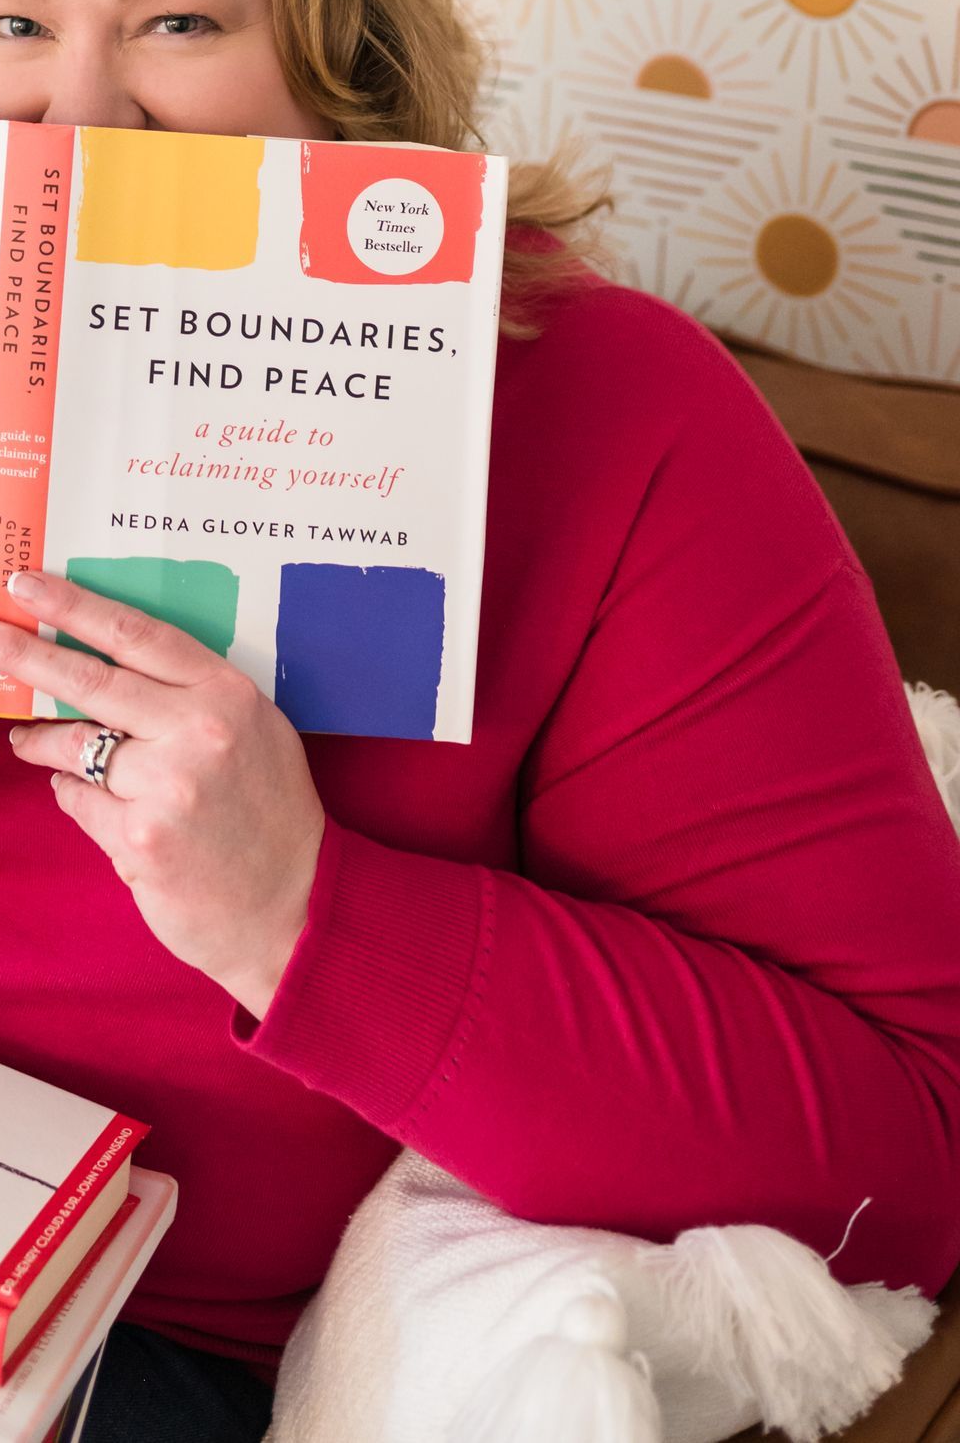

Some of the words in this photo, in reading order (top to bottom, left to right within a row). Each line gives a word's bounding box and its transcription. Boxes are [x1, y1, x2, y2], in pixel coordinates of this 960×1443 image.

[42, 168, 60, 211] SET
[364, 200, 395, 213] New
[400, 202, 430, 215] York
[9, 204, 28, 263] FIND
[364, 238, 423, 253] Bestseller
[377, 219, 416, 233] Times
[3, 276, 22, 354] PEACE
[26, 224, 56, 394] BOUNDARIES,
[88, 304, 160, 333] SET
[180, 309, 457, 357] BOUNDARIES,
[148, 359, 243, 389] FIND
[265, 367, 392, 401] PEACE
[0, 430, 31, 443] guide
[34, 434, 46, 443] to
[195, 422, 209, 439] a
[219, 419, 298, 447] guide
[309, 428, 334, 446] to
[128, 453, 278, 489] reclaiming
[286, 467, 404, 498] yourself
[18, 527, 32, 572] NEDR
[111, 513, 189, 532] NEDRA
[202, 518, 295, 538] GLOVER
[308, 525, 409, 546] TAWWAB
[12, 1245, 42, 1279] HENRY
[36, 1215, 65, 1248] CLOUD
[76, 1170, 99, 1197] JOHN
[92, 1127, 133, 1174] TOWNSEND
